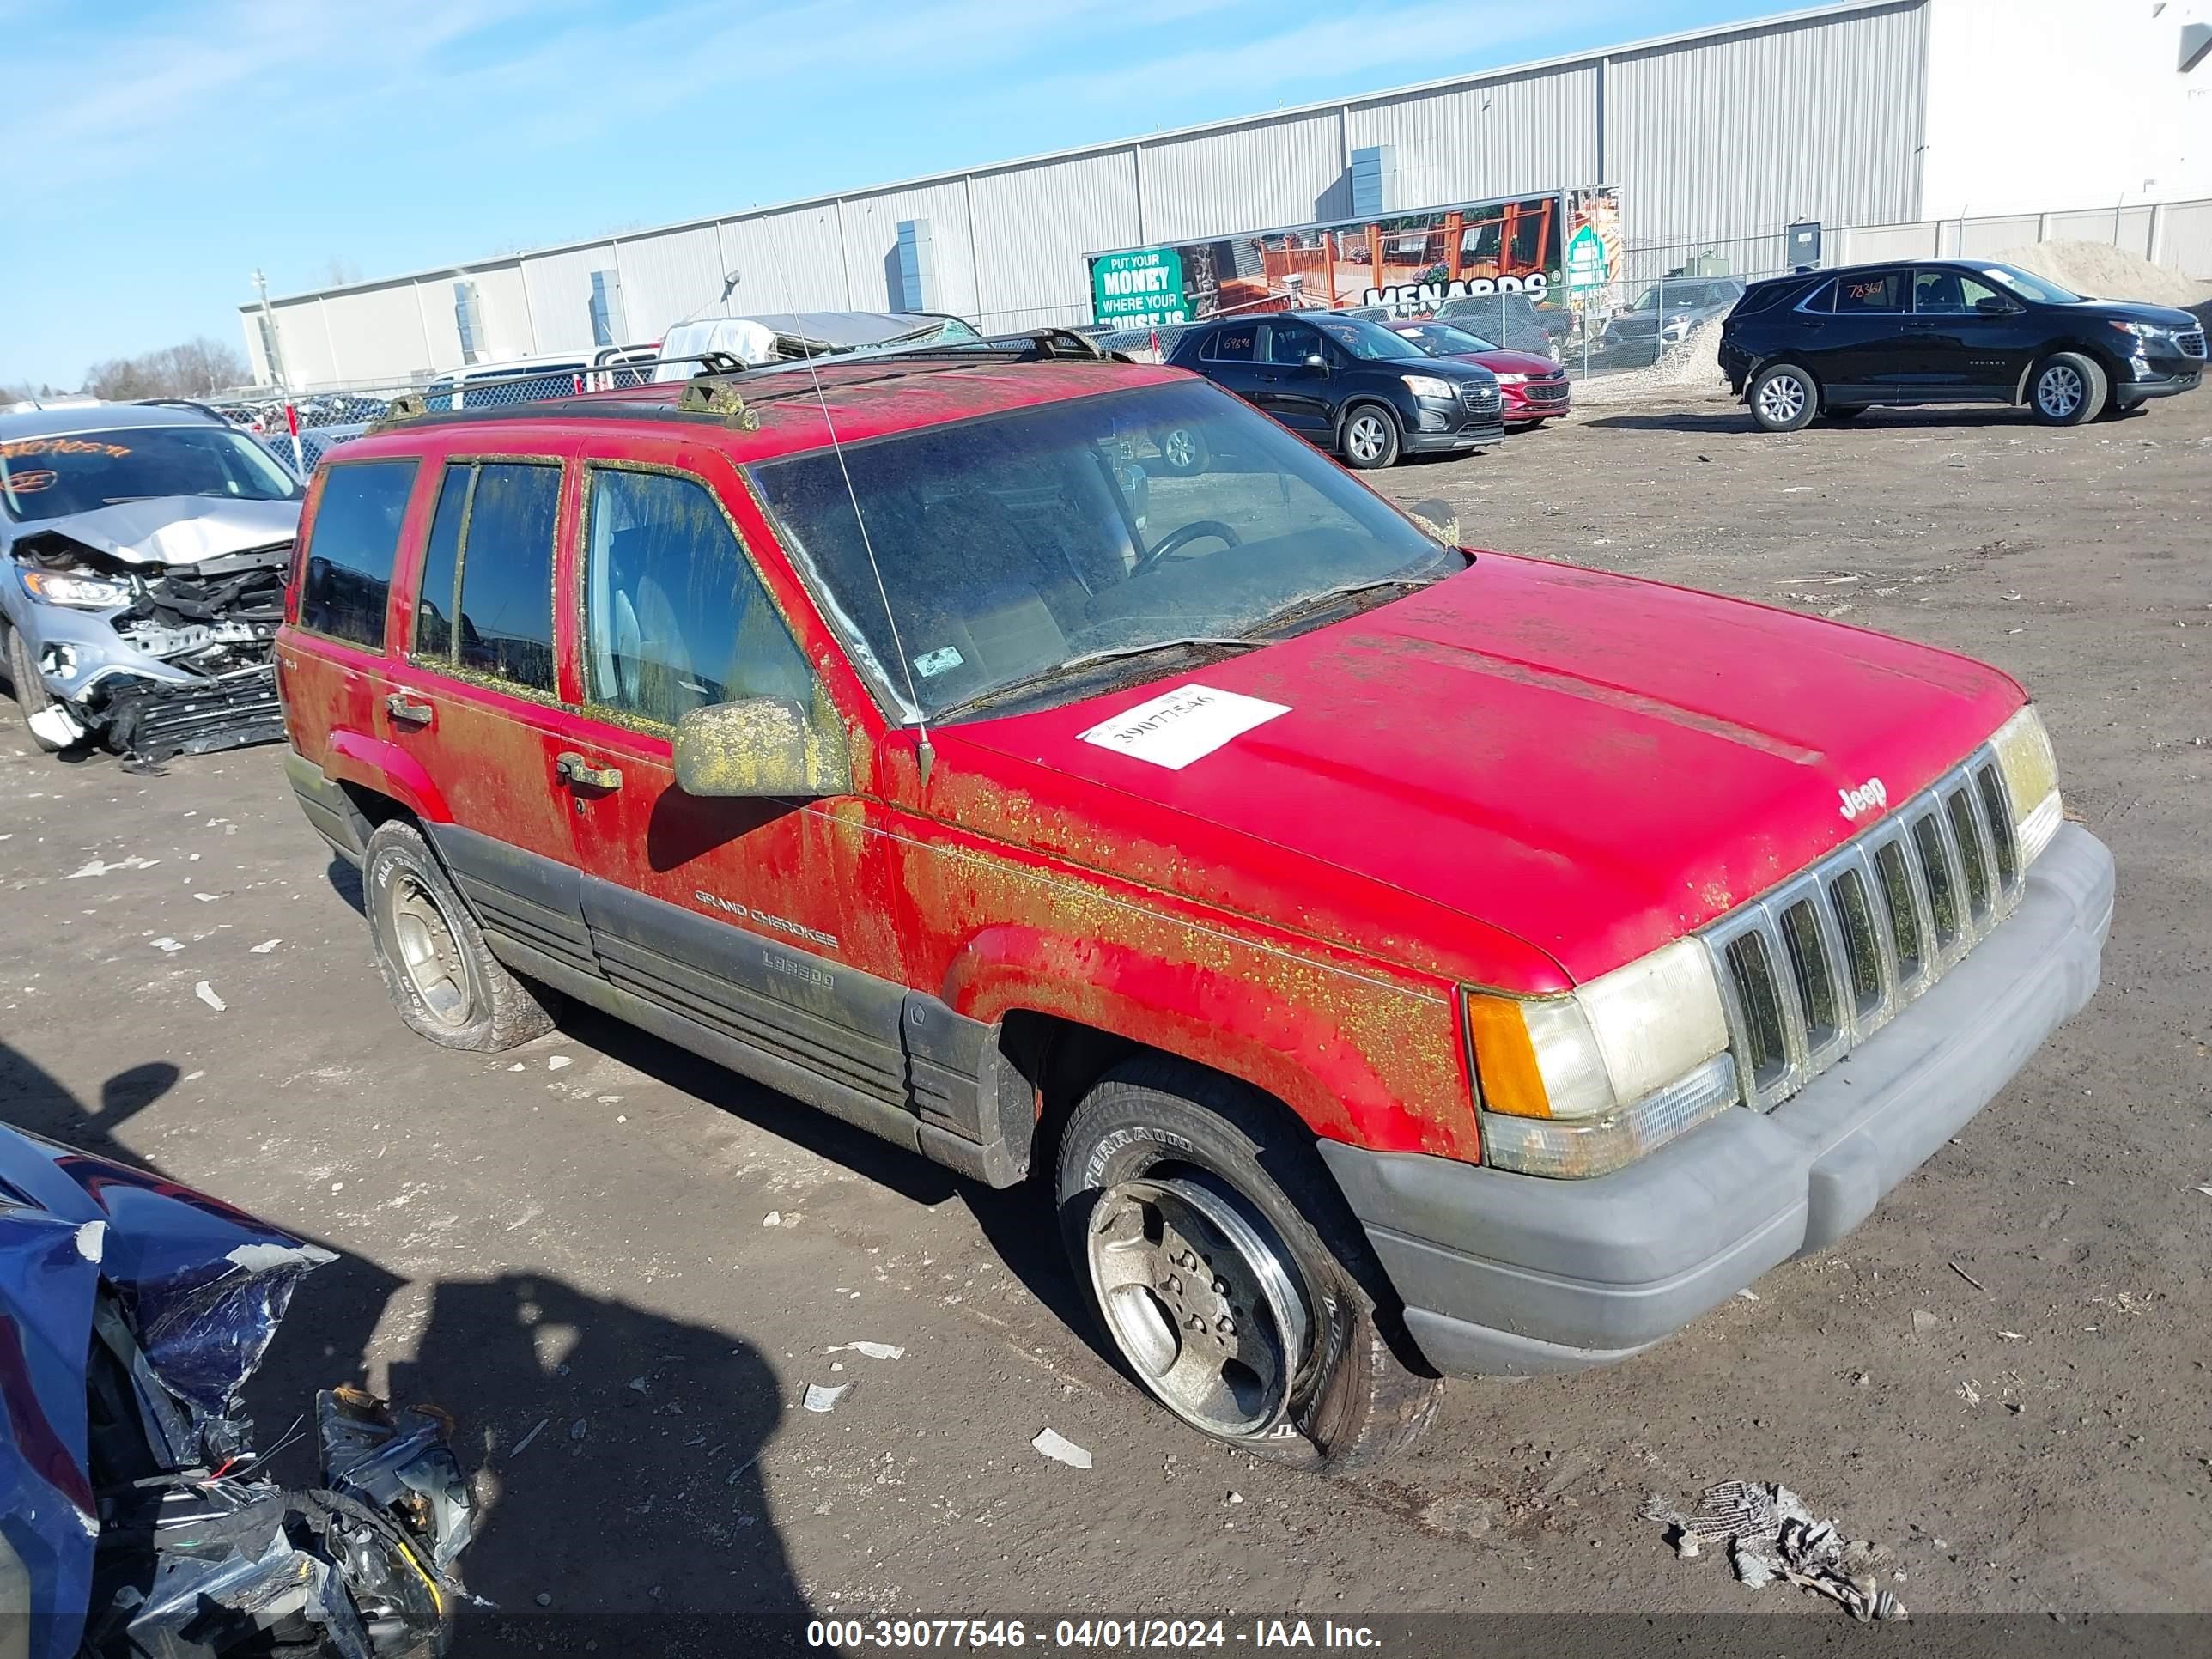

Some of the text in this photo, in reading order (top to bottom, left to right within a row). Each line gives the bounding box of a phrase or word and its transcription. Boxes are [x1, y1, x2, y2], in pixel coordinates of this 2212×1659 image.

[1103, 266, 1170, 296] MONEY
[1110, 254, 1159, 270] PUT YOUR
[1103, 293, 1177, 313] WHERE YOUR
[1113, 695, 1216, 744] 39077546
[1838, 777, 1887, 821] Jeep
[695, 890, 839, 949] GRAND CHEROKEE
[762, 948, 836, 989] LAREDO
